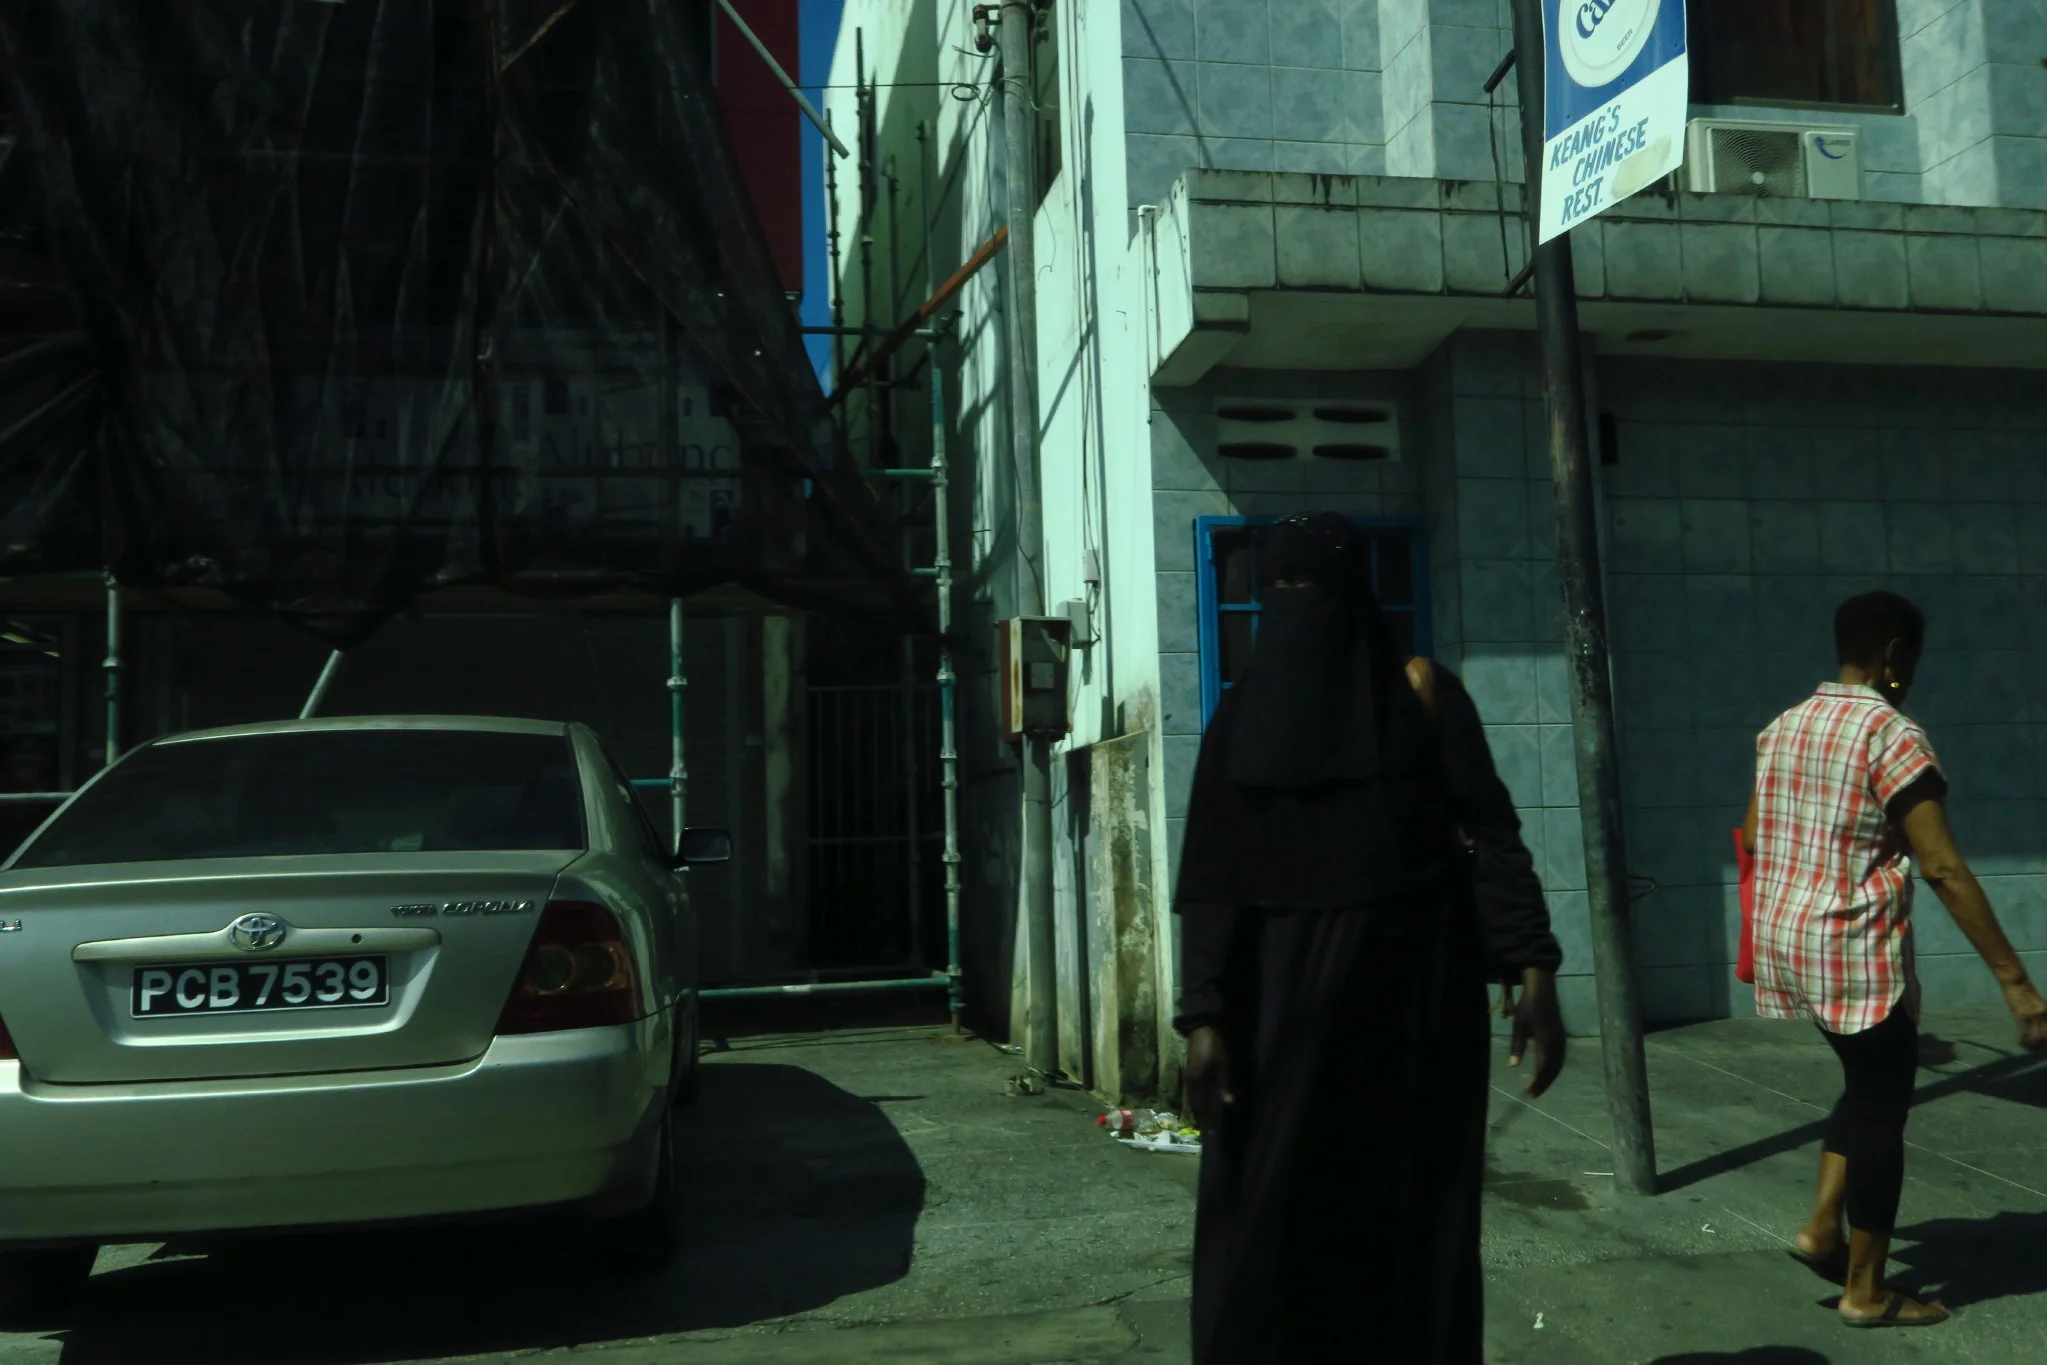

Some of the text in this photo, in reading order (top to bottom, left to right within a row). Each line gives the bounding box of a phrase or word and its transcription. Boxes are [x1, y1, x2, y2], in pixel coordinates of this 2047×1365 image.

[1616, 28, 1633, 51] BEER
[1550, 104, 1621, 171] KEANG'S
[1573, 117, 1648, 187] CHINESE
[1561, 176, 1604, 225] REST.
[441, 900, 535, 916] COROLLA
[140, 960, 379, 1011] PCB 7539
